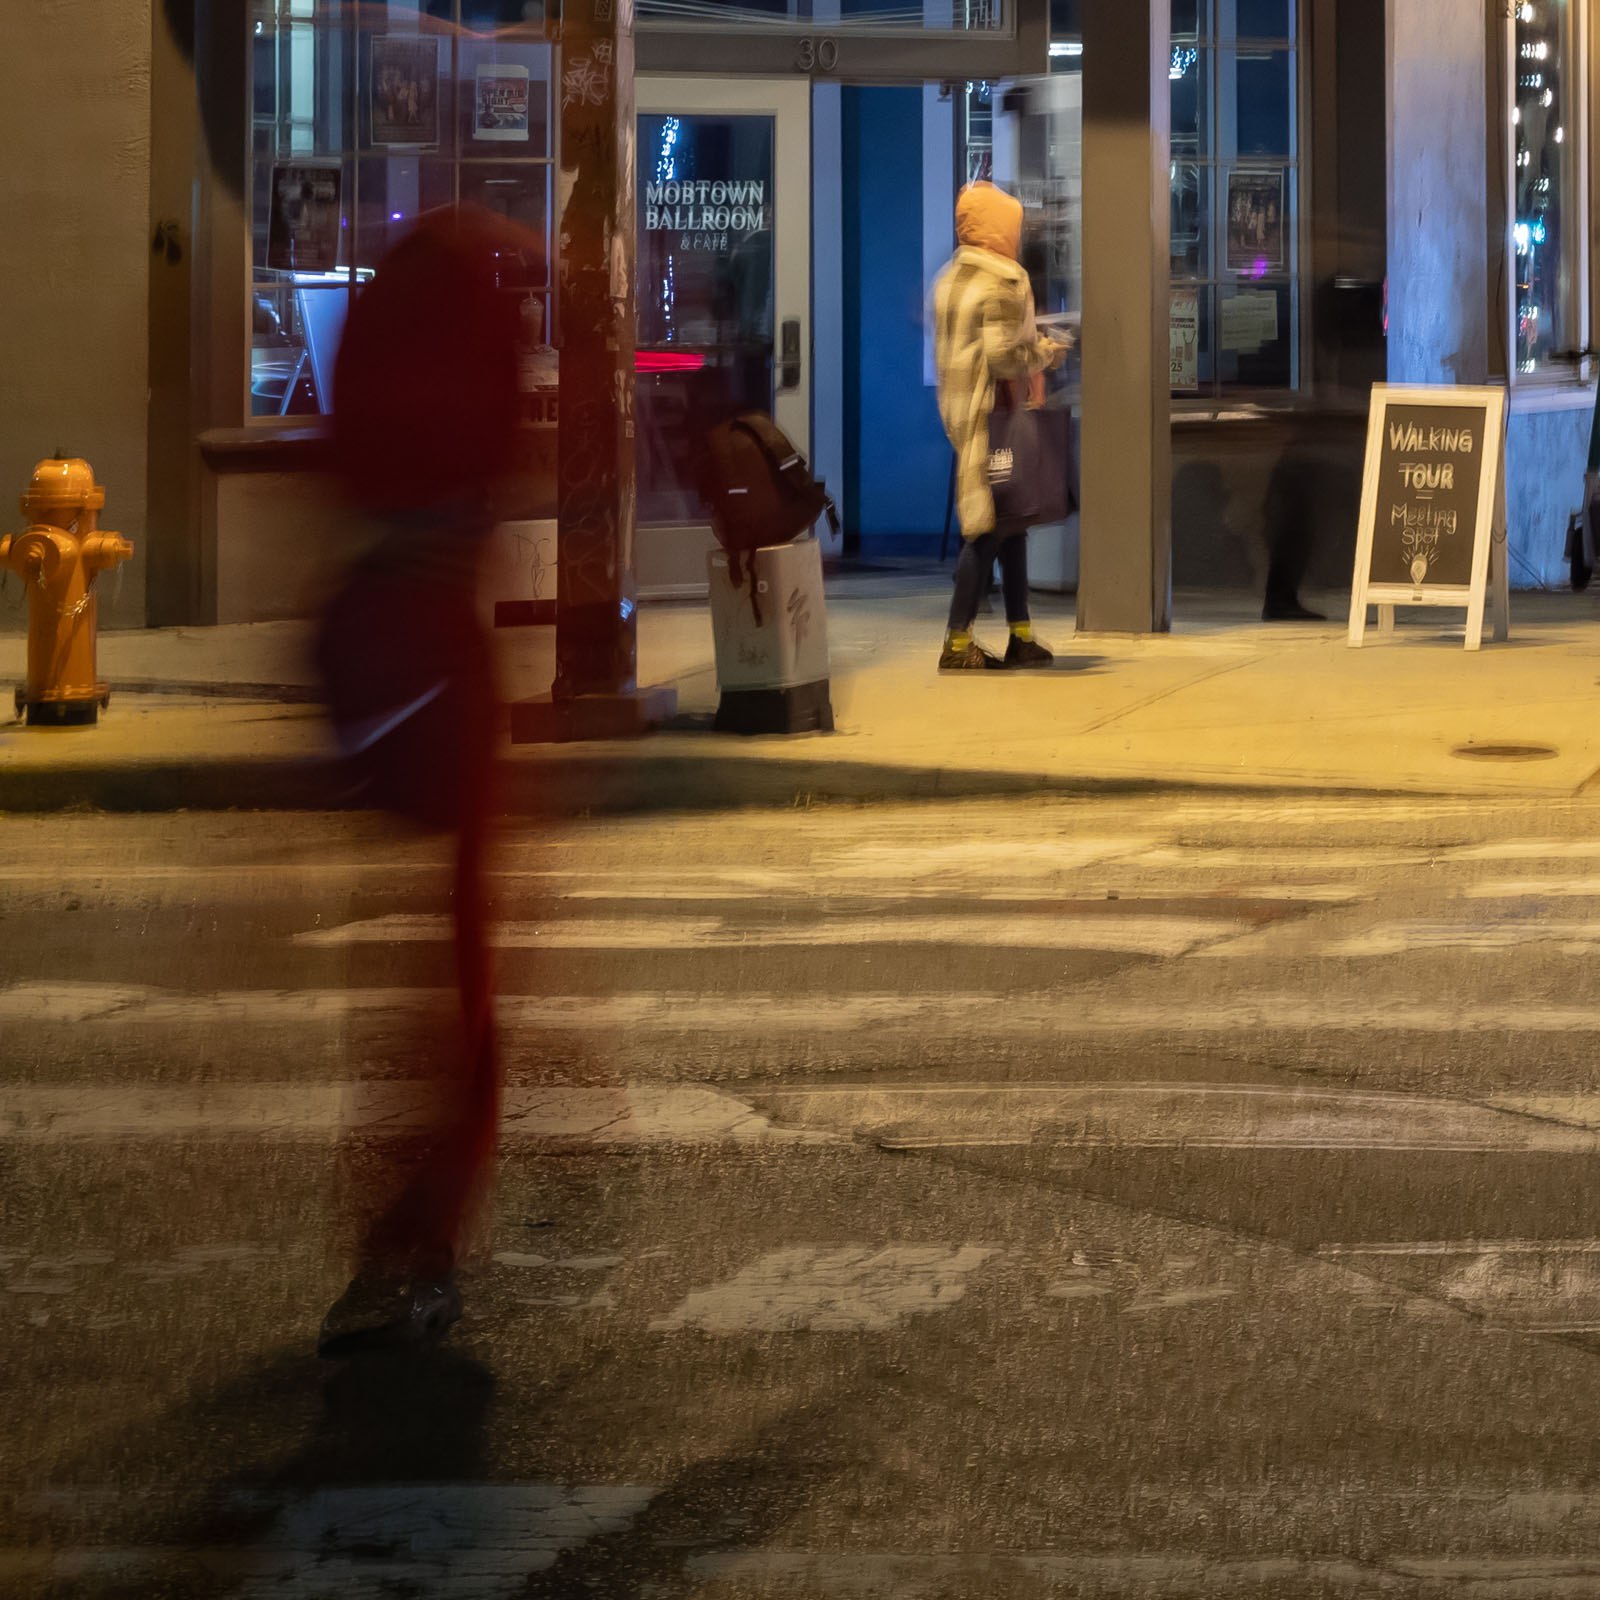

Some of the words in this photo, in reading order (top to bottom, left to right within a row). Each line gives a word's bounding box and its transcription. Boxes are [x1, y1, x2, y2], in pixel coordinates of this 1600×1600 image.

[797, 37, 839, 72] 30
[645, 181, 764, 205] MOBTOWN
[645, 206, 764, 231] BALLROOM
[1389, 422, 1474, 454] WALKING
[1397, 462, 1456, 490] TOUR
